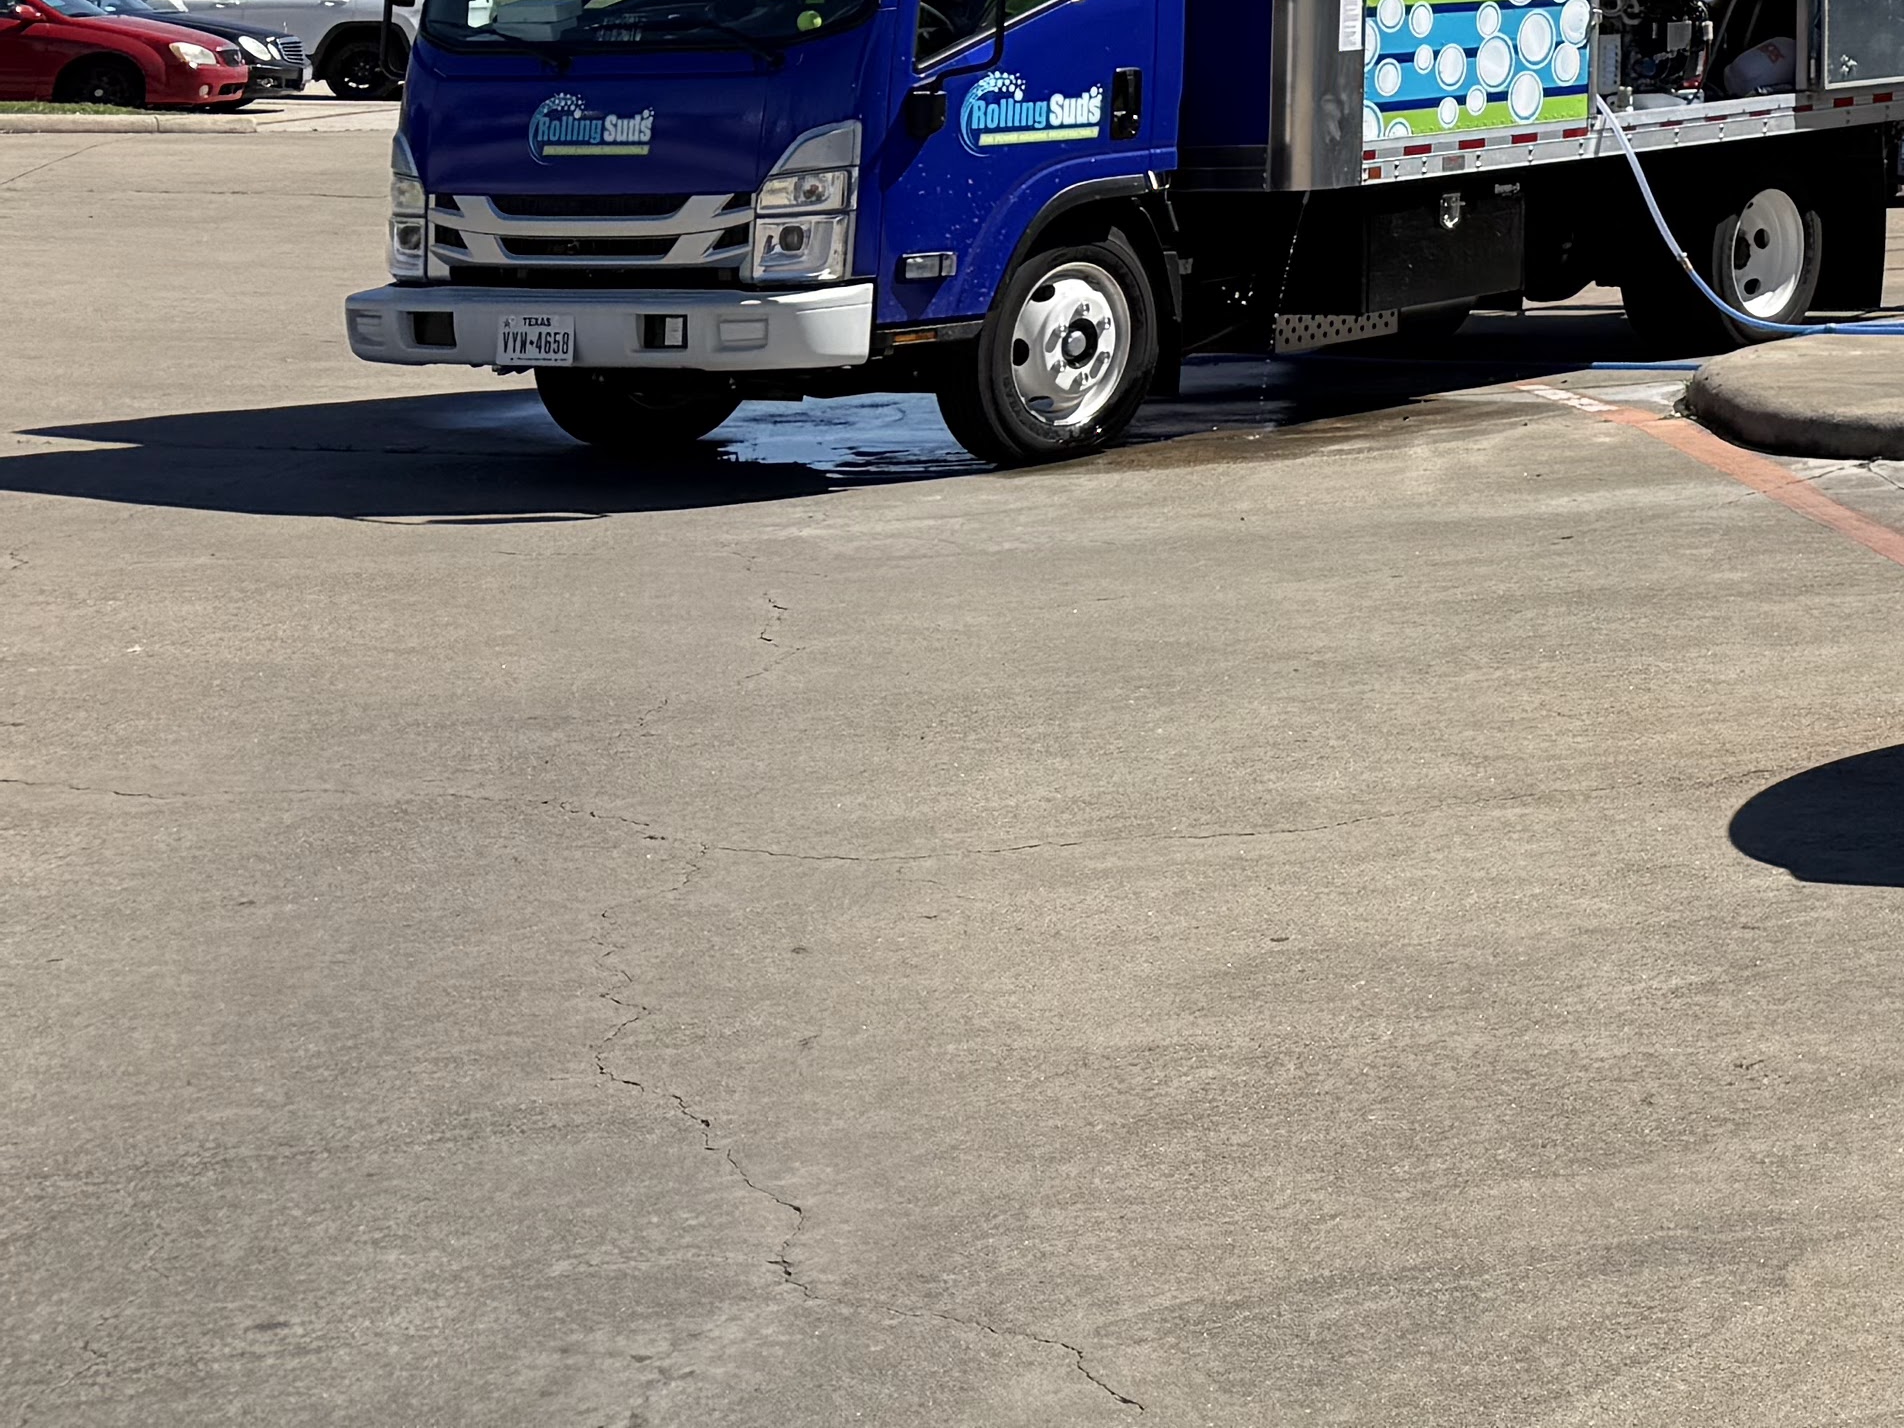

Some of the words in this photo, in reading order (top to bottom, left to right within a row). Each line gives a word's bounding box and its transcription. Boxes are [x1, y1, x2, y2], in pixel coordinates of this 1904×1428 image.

[971, 98, 1048, 129] Rolling
[1049, 92, 1103, 126] Suds
[537, 116, 602, 143] Rolling
[603, 114, 653, 142] Suds
[523, 317, 551, 326] TEXAS
